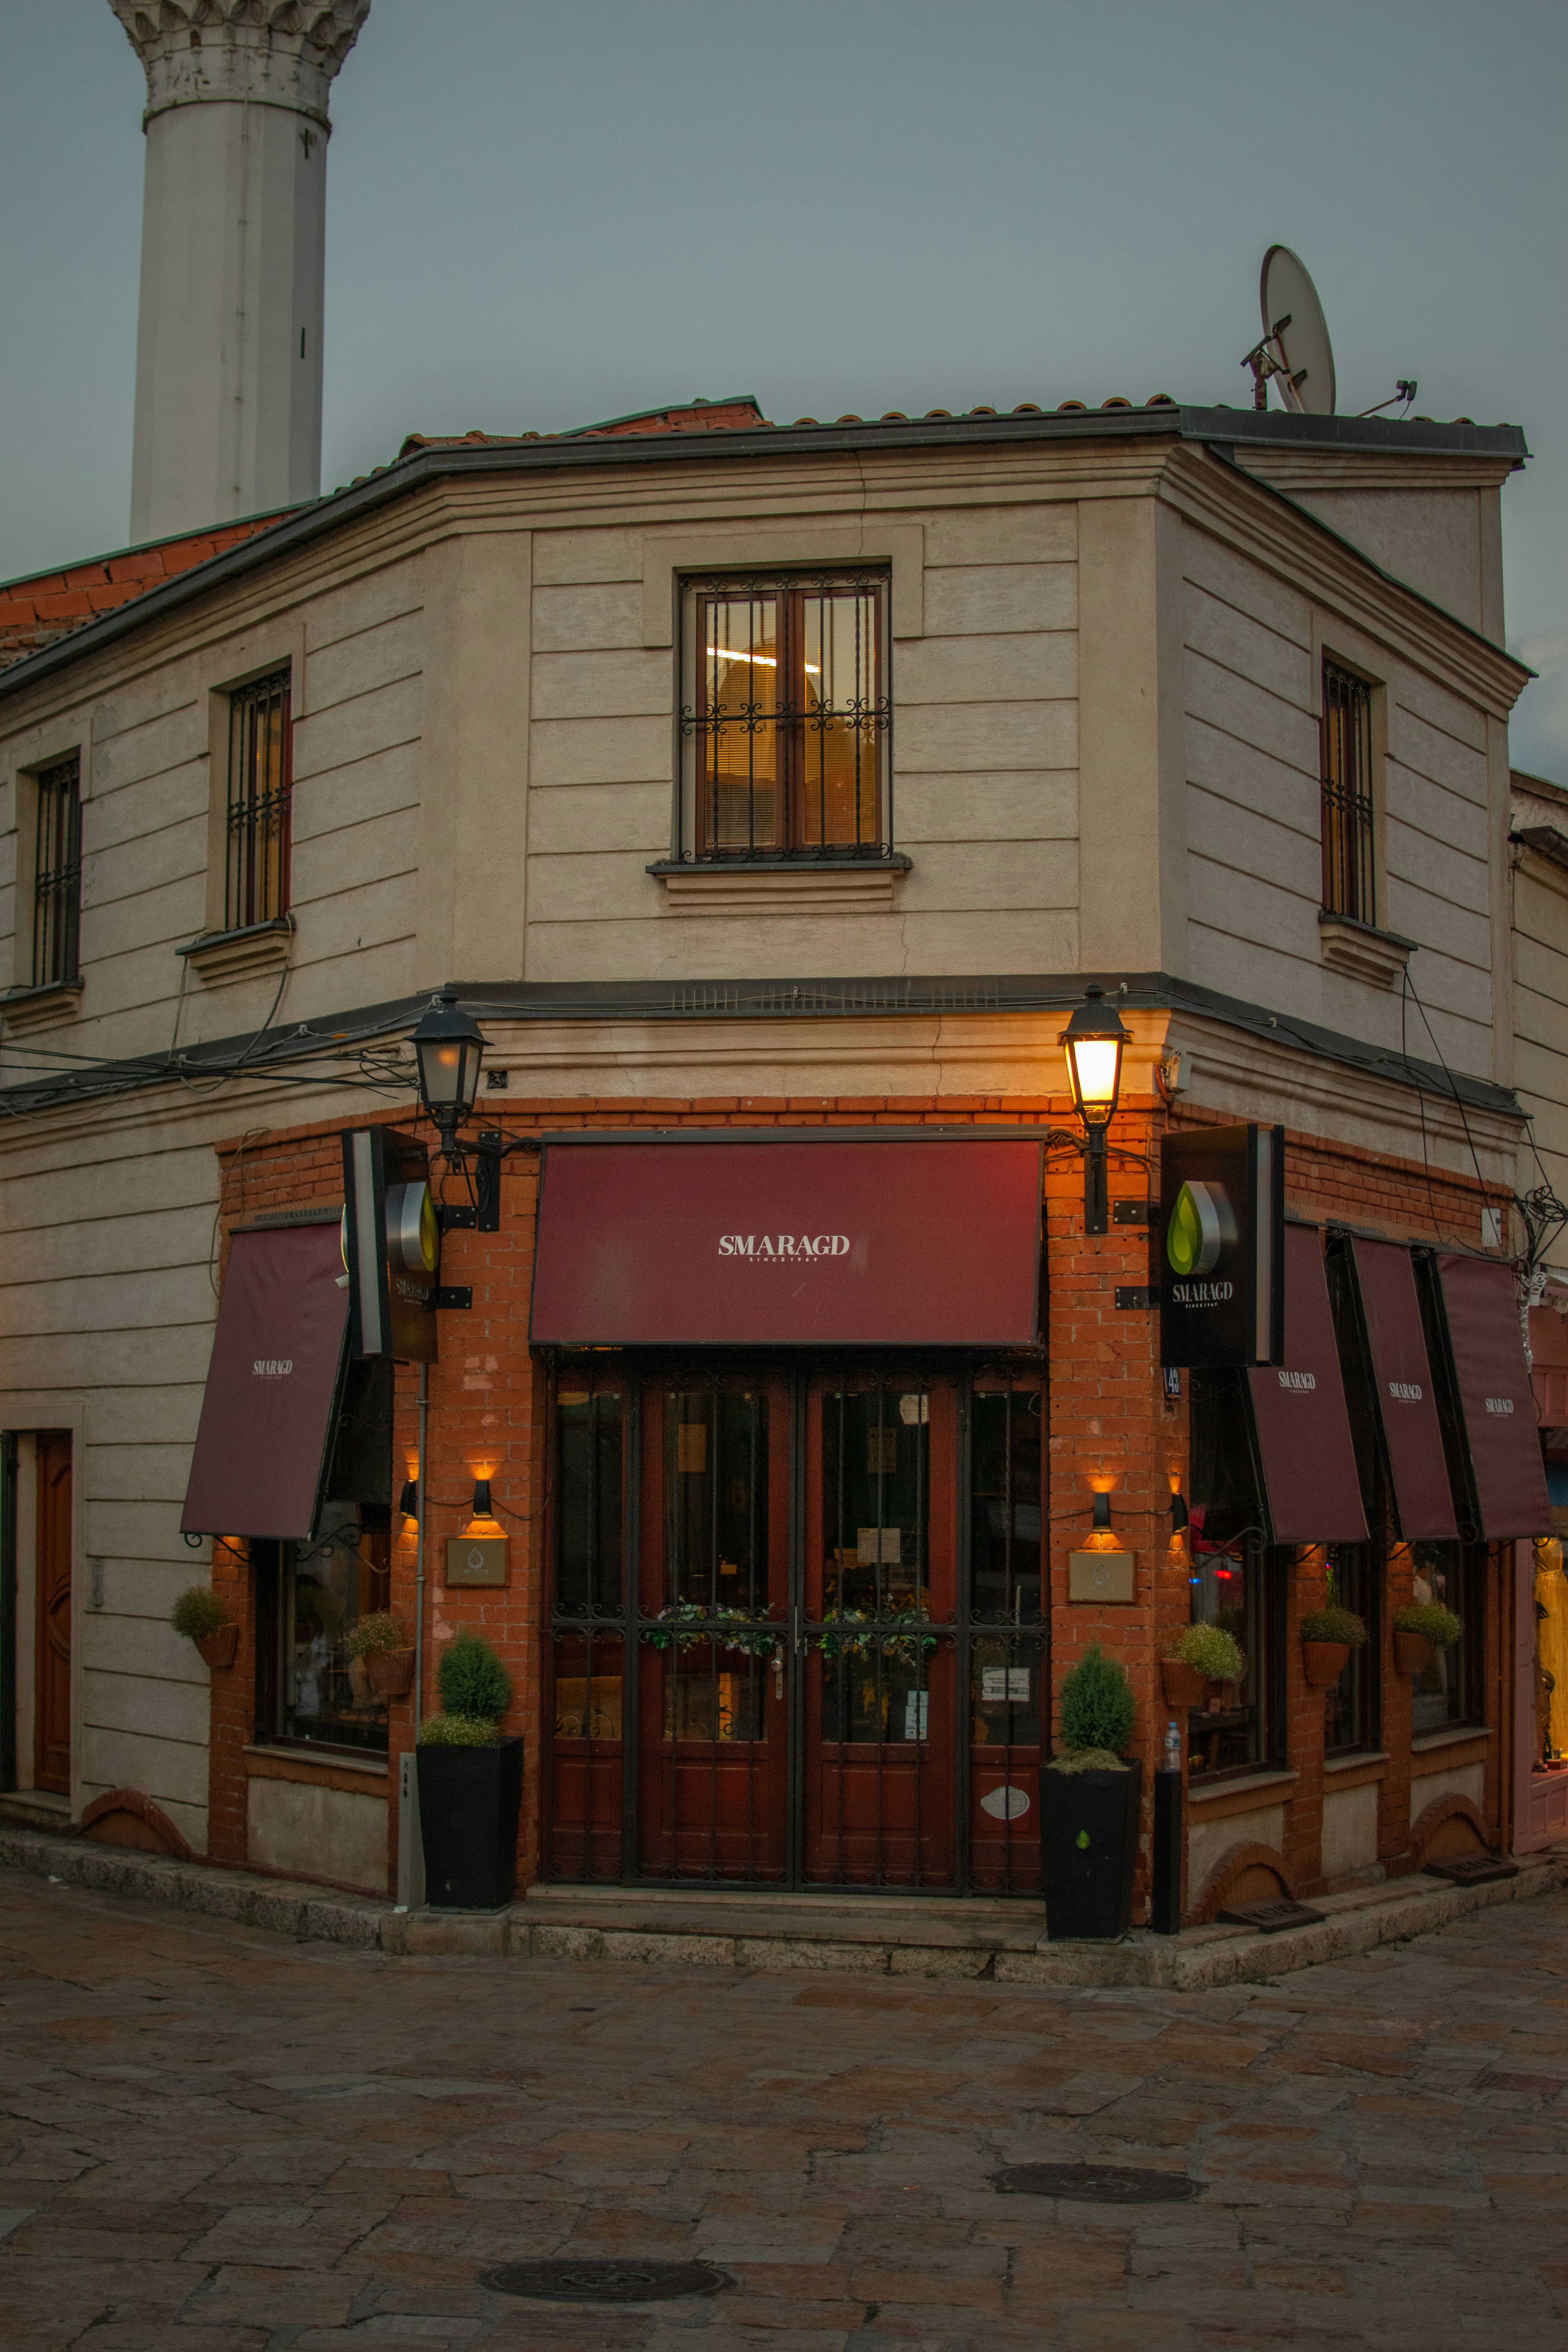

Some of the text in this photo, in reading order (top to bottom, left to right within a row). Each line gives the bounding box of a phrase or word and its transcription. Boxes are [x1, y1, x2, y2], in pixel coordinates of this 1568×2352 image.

[719, 1235, 850, 1255] SMARAGD
[1172, 1281, 1232, 1302] SMARAGD
[252, 1359, 293, 1374] SMARAGD
[1278, 1371, 1315, 1389] SMARAGD
[1389, 1382, 1422, 1400] SMARAGD
[1485, 1398, 1513, 1413] SMARAGD
